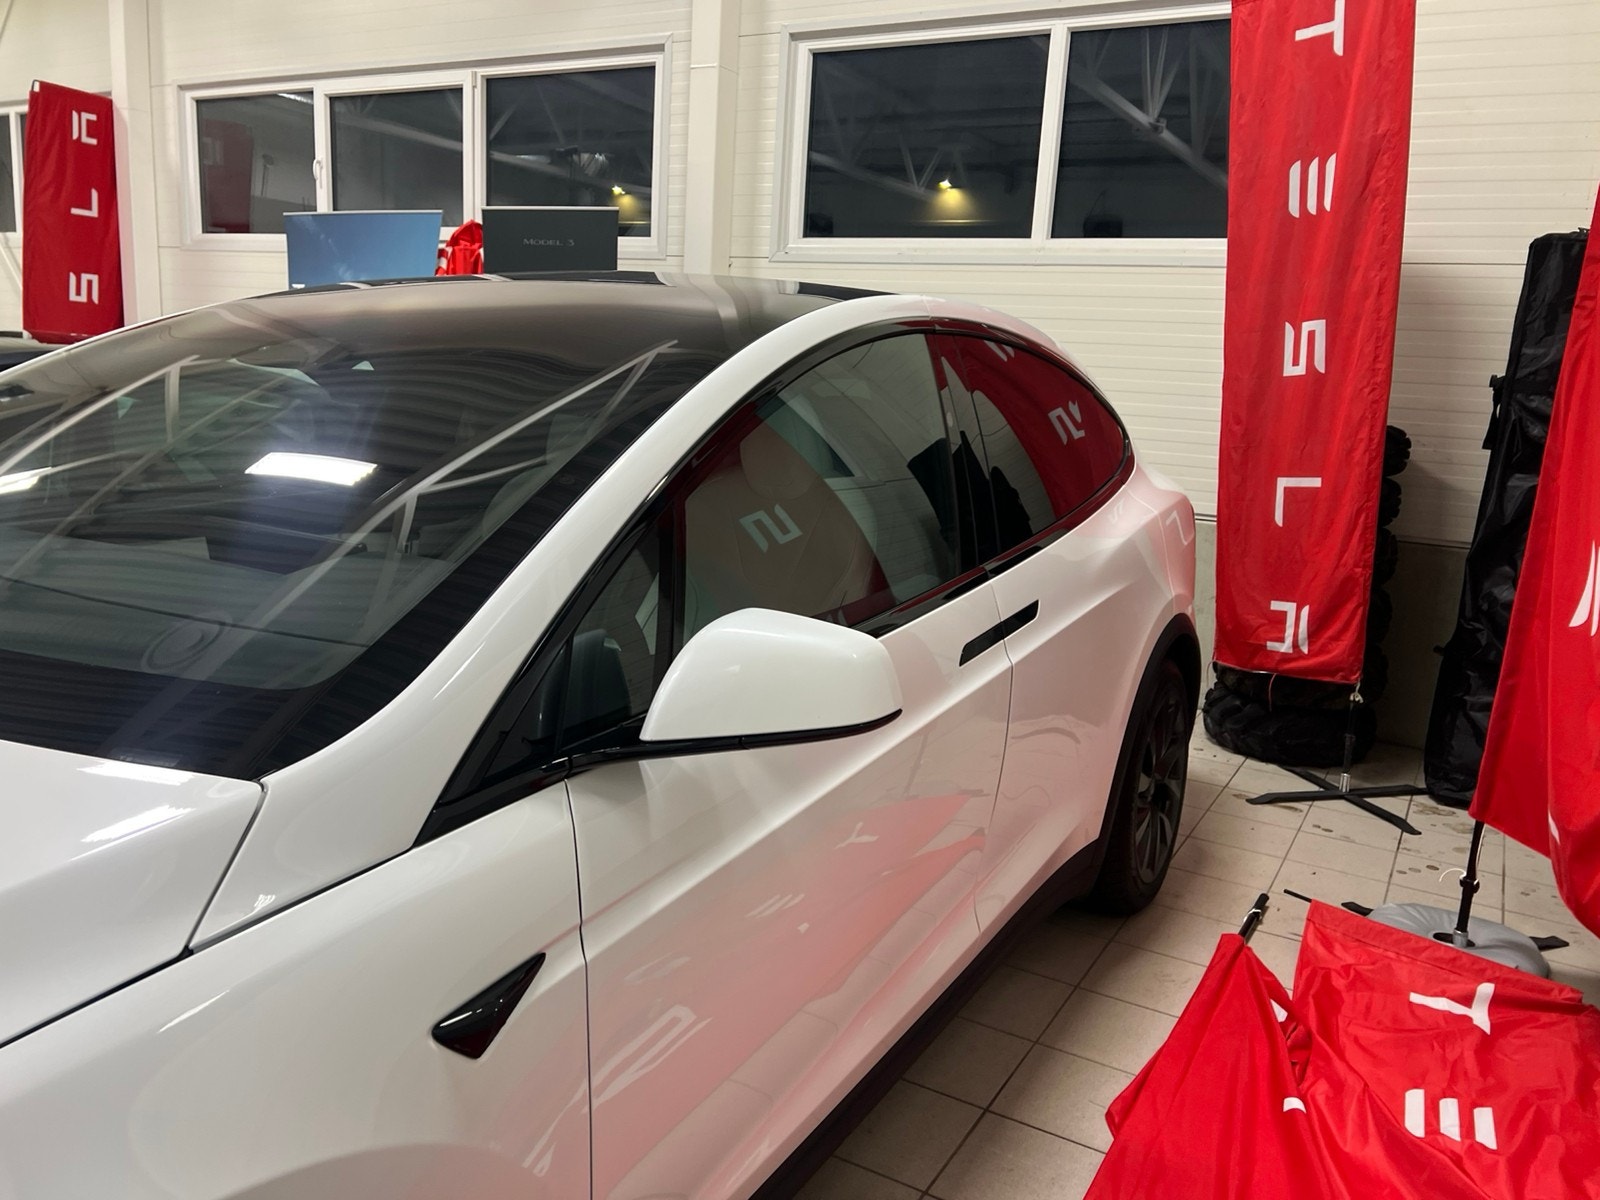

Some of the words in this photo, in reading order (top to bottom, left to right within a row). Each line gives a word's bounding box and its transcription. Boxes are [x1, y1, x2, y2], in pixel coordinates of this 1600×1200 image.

[522, 238, 564, 246] MODEL
[567, 238, 575, 247] 3
[1266, 0, 1345, 654] TESLA
